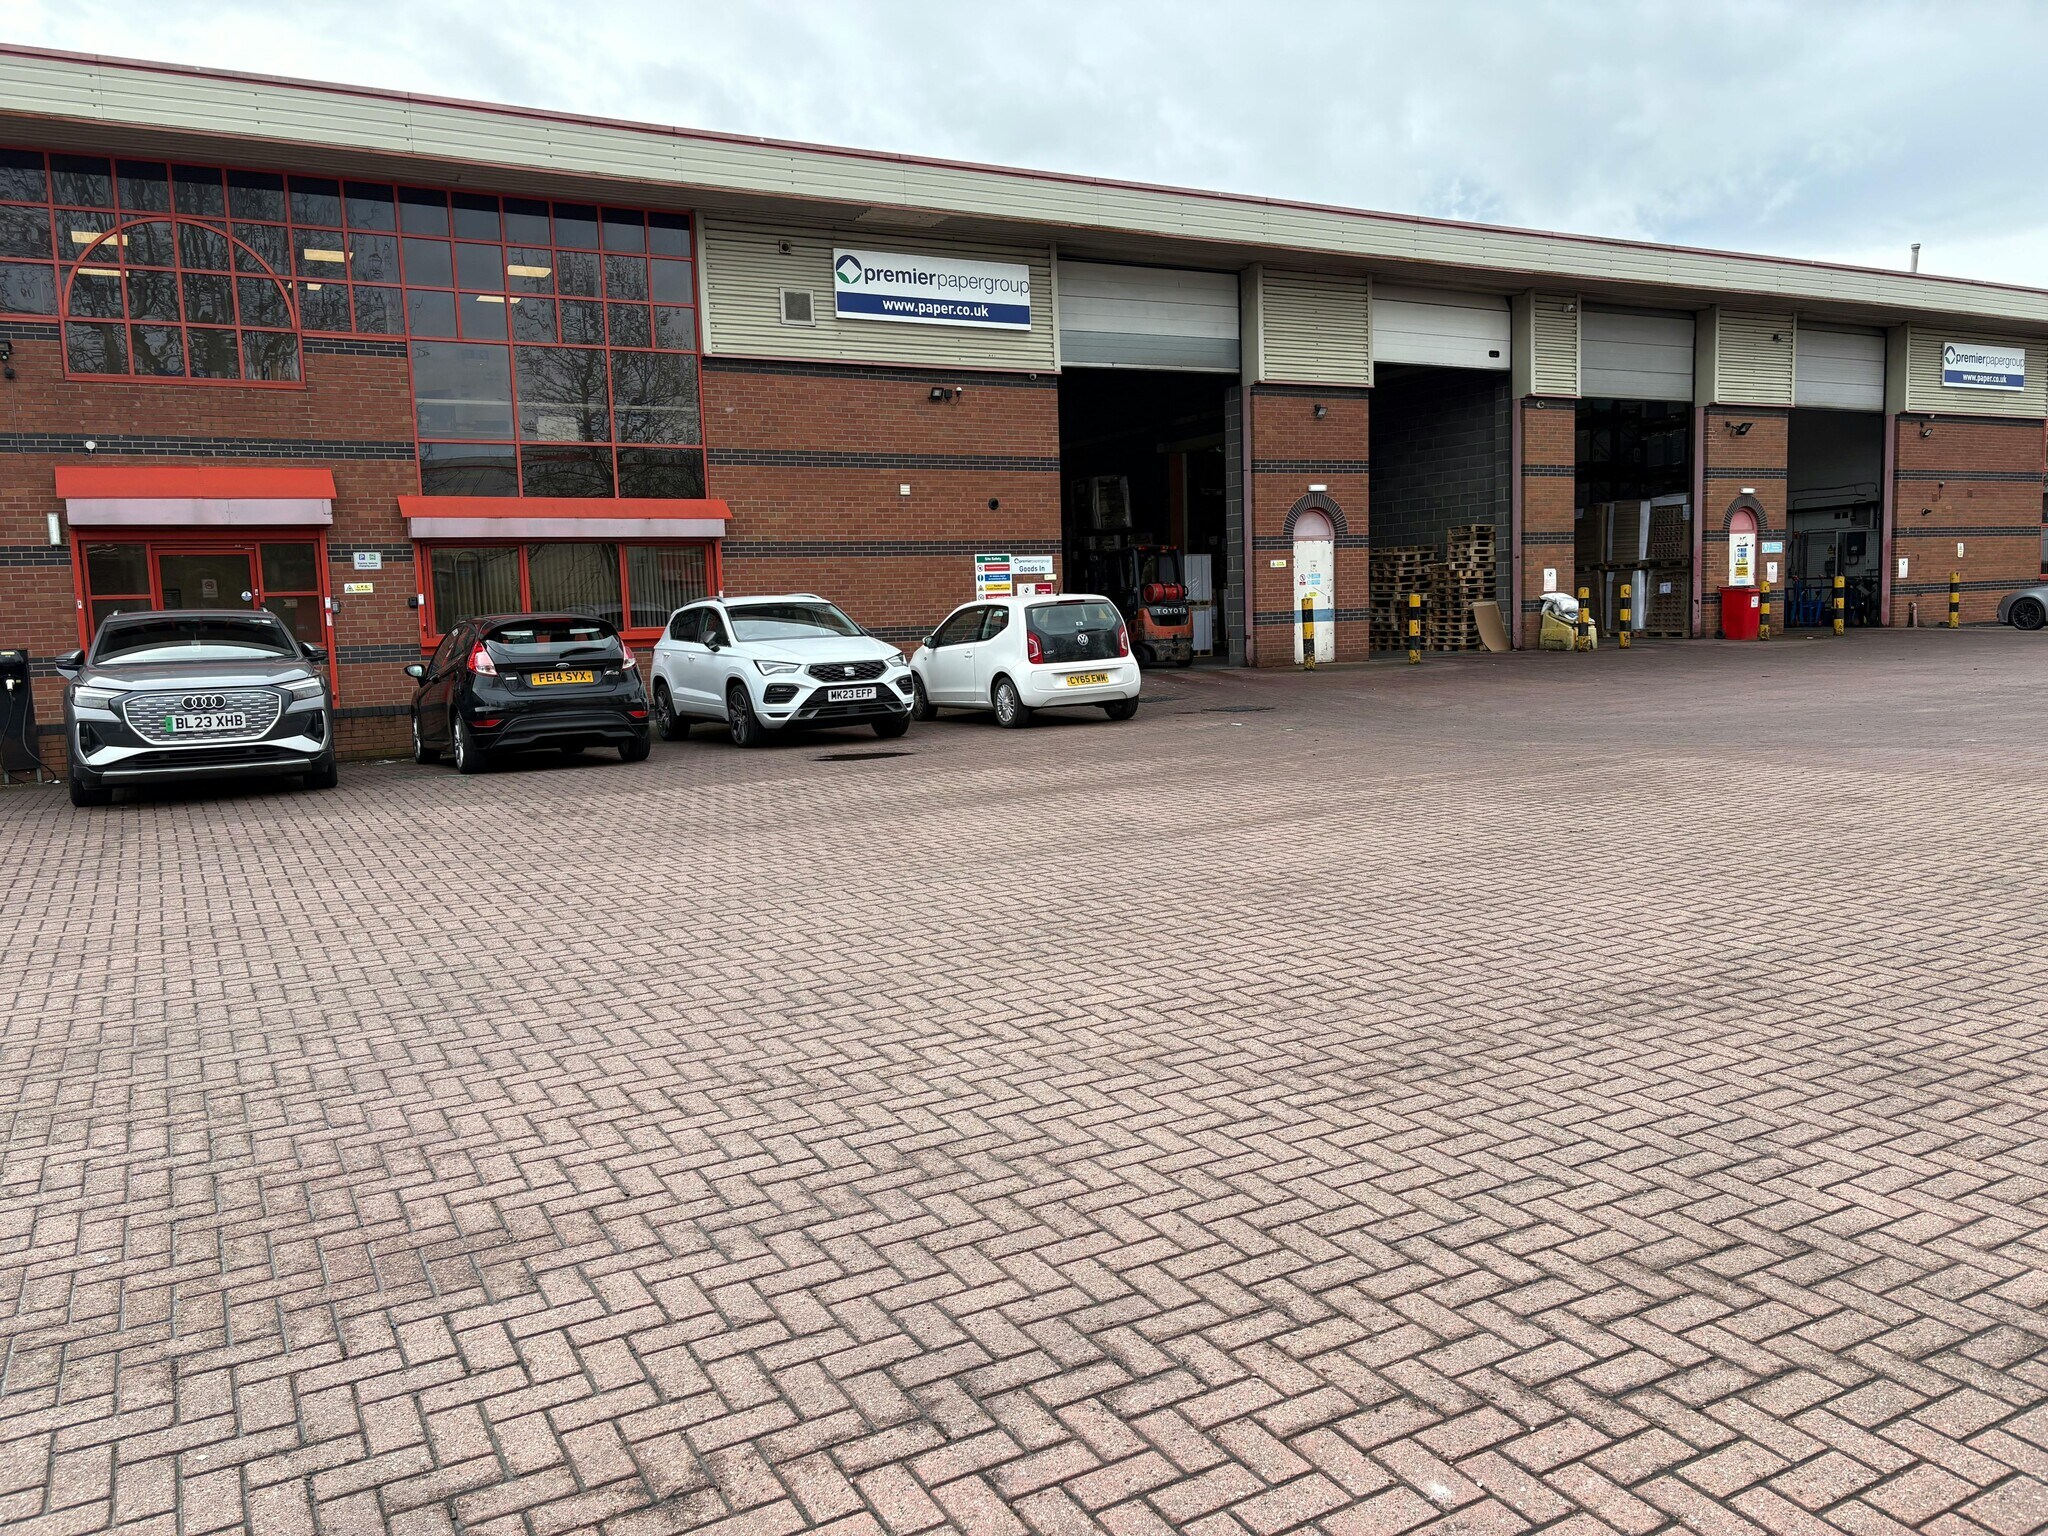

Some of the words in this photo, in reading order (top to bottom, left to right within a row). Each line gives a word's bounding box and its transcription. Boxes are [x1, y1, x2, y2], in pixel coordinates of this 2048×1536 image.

[864, 267, 1030, 297] premierpapergroup
[882, 299, 989, 317] www.paper.co.uk
[1956, 353, 2025, 369] premierpapergroup
[1962, 374, 2007, 383] www.paper.co.uk
[1156, 607, 1187, 615] TOYOTA
[565, 671, 587, 681] SYX
[856, 688, 873, 698] EFP
[175, 716, 212, 729] BL23
[216, 715, 243, 727] XHB
